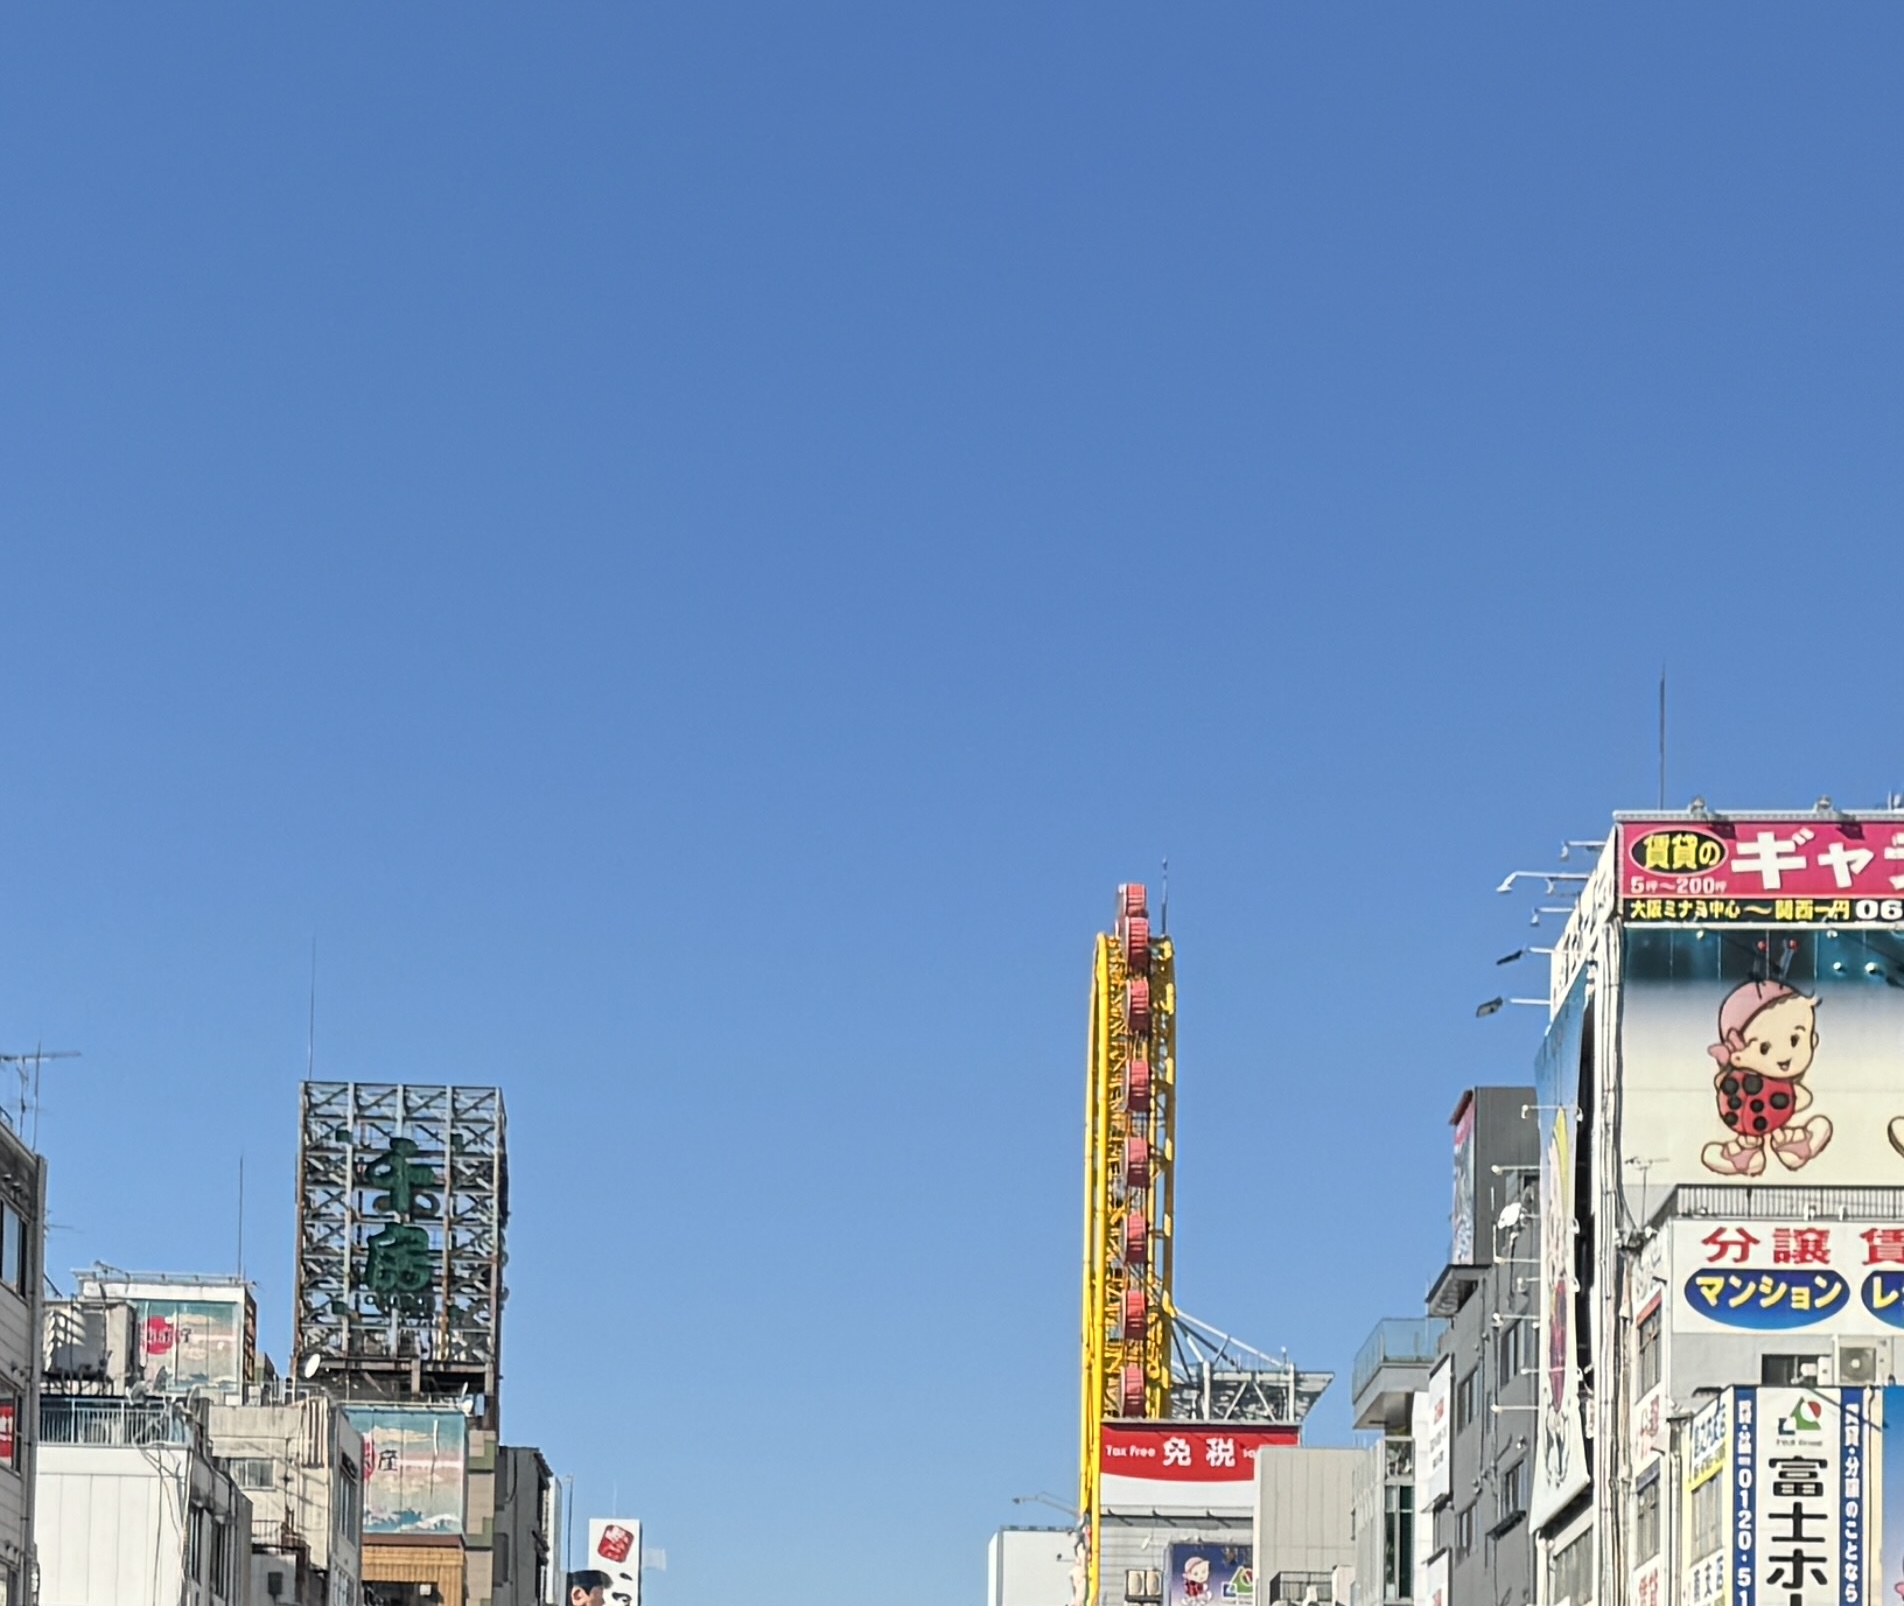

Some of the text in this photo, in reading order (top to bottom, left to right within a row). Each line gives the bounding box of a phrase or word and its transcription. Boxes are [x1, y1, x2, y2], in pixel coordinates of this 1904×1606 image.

[1643, 833, 1721, 870] 賃貸の
[1695, 1274, 1843, 1311] マンション
[1162, 1436, 1236, 1468] 免税
